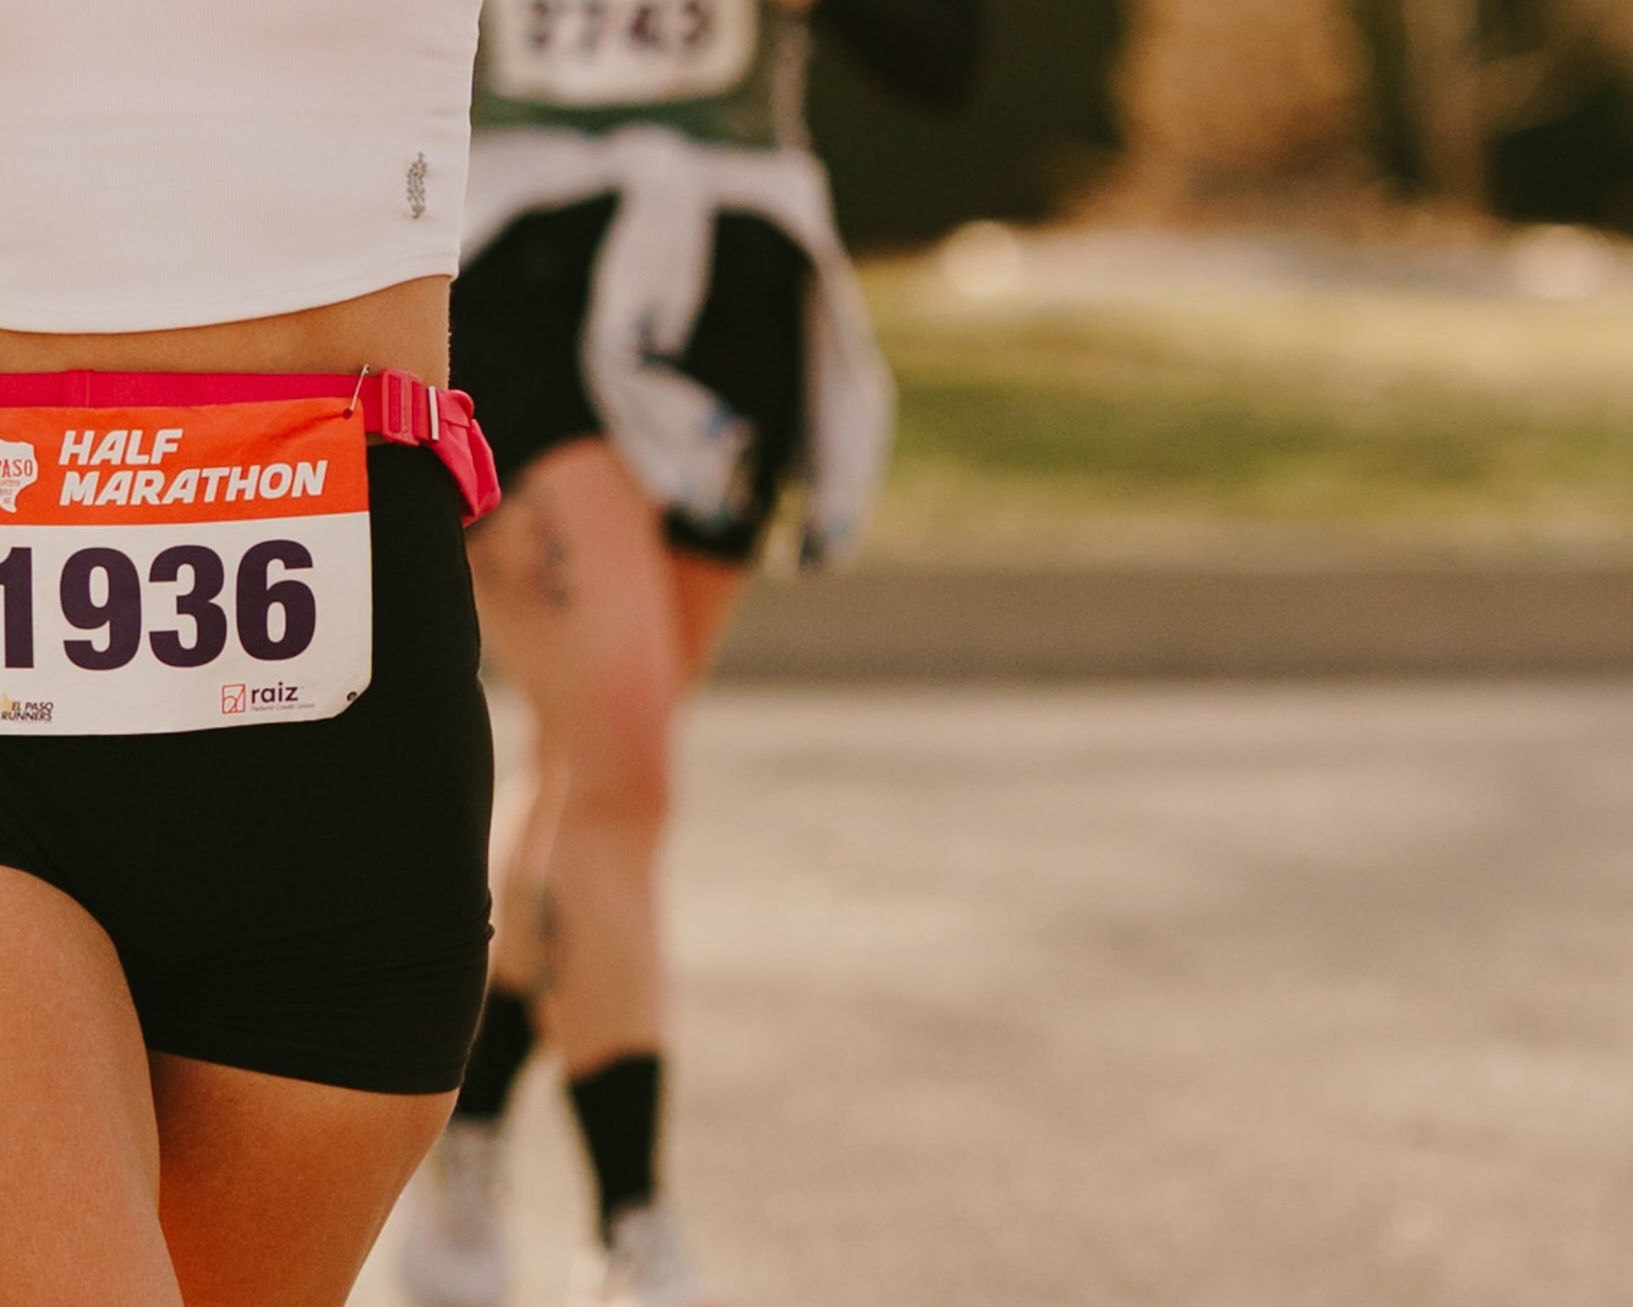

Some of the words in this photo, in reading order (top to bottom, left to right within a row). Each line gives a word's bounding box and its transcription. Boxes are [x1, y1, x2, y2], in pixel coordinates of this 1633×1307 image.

[59, 428, 183, 465] HALF
[59, 460, 328, 506] MARATHON
[251, 681, 299, 704] raiz
